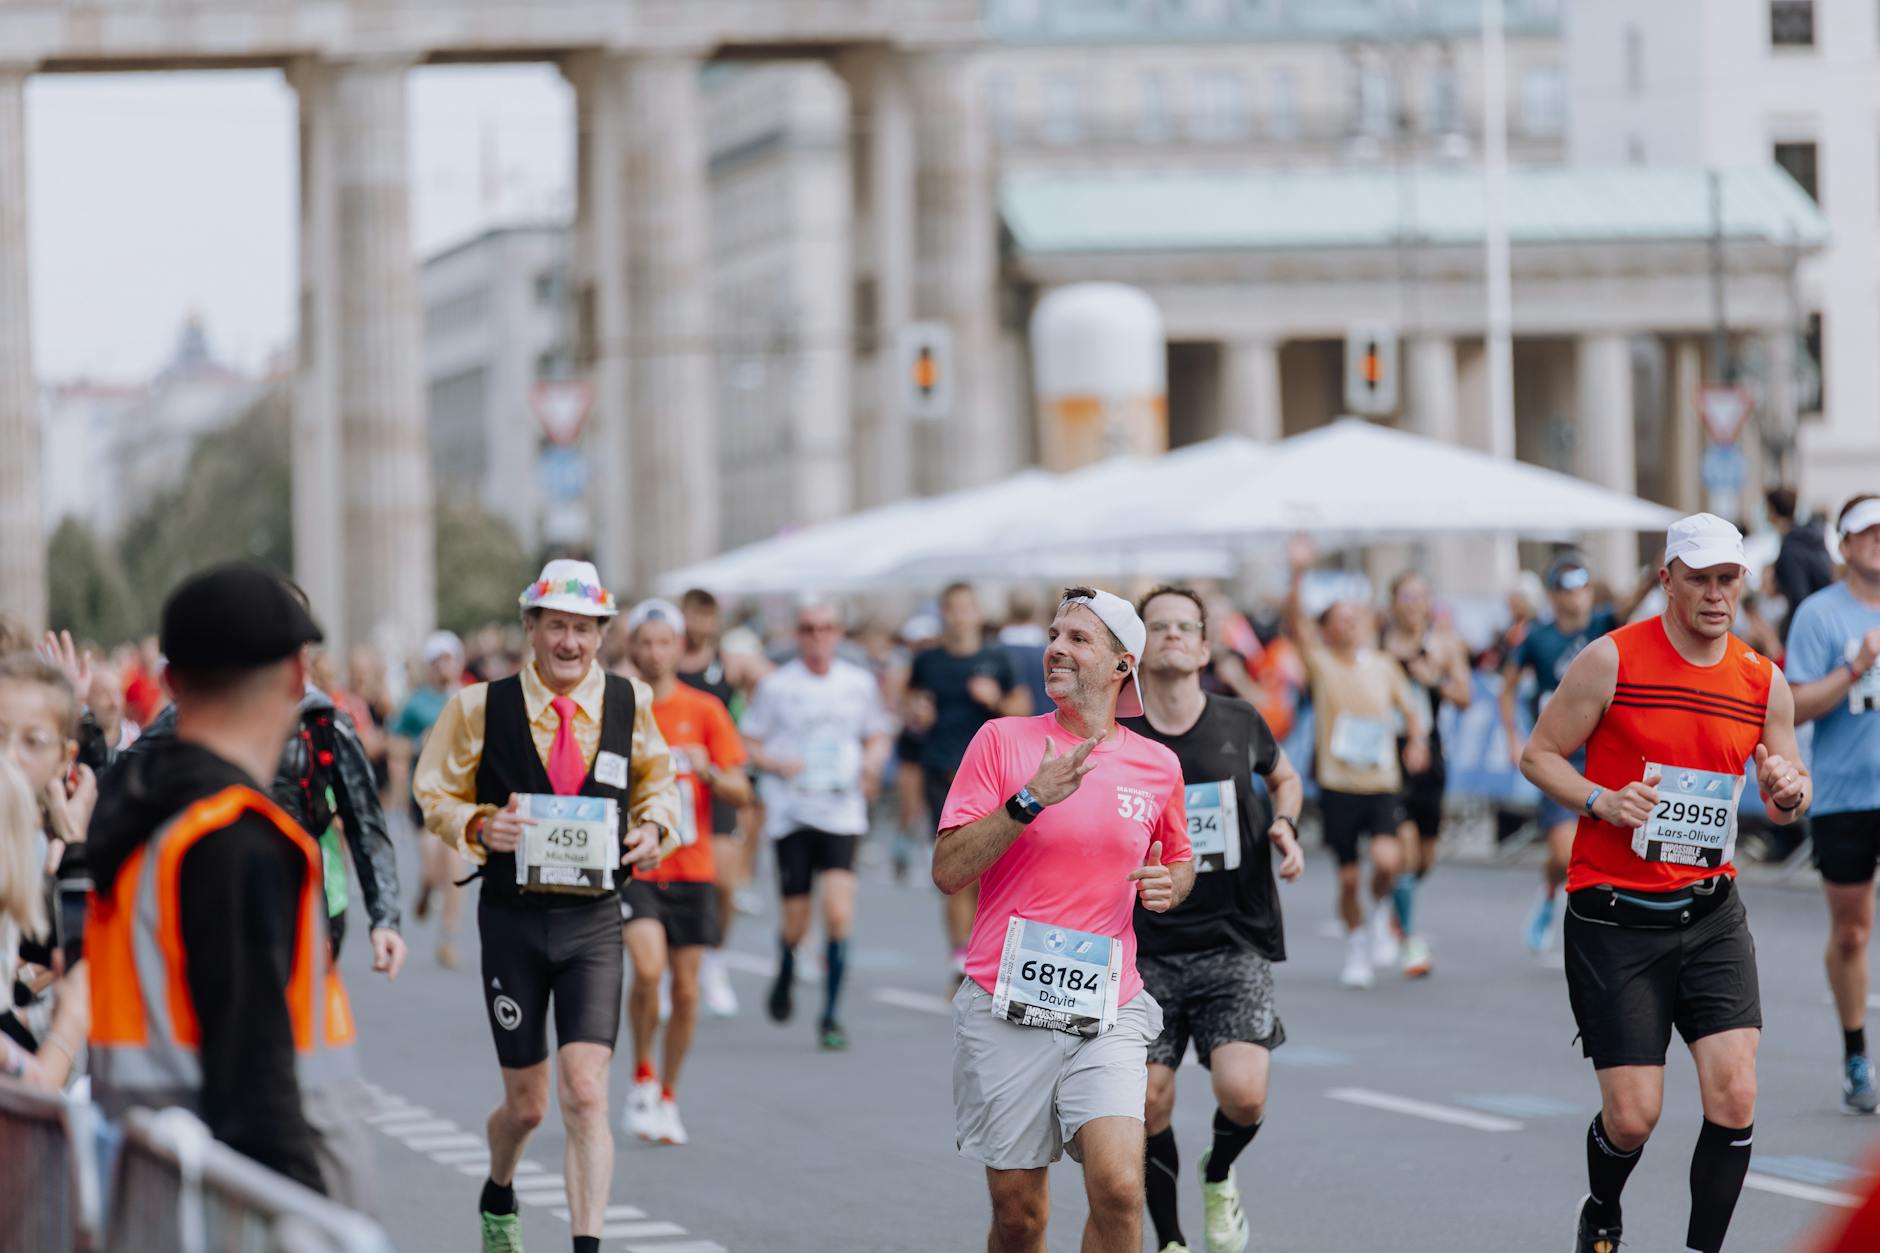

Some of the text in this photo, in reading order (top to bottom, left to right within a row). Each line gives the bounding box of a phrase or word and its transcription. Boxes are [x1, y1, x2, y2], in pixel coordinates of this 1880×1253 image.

[1656, 800, 1728, 828] 29958
[1187, 815, 1217, 834] 34
[547, 827, 588, 848] 459
[1657, 825, 1721, 845] Lars-Oliver
[1660, 852, 1697, 866] IS NOTHING
[1661, 841, 1702, 858] IMPOSSIBLE
[1021, 960, 1099, 995] 68184
[1039, 989, 1076, 1008] David
[1022, 1014, 1068, 1032] IS NOTHING
[1025, 1004, 1072, 1025] IMPOSSIBLE
